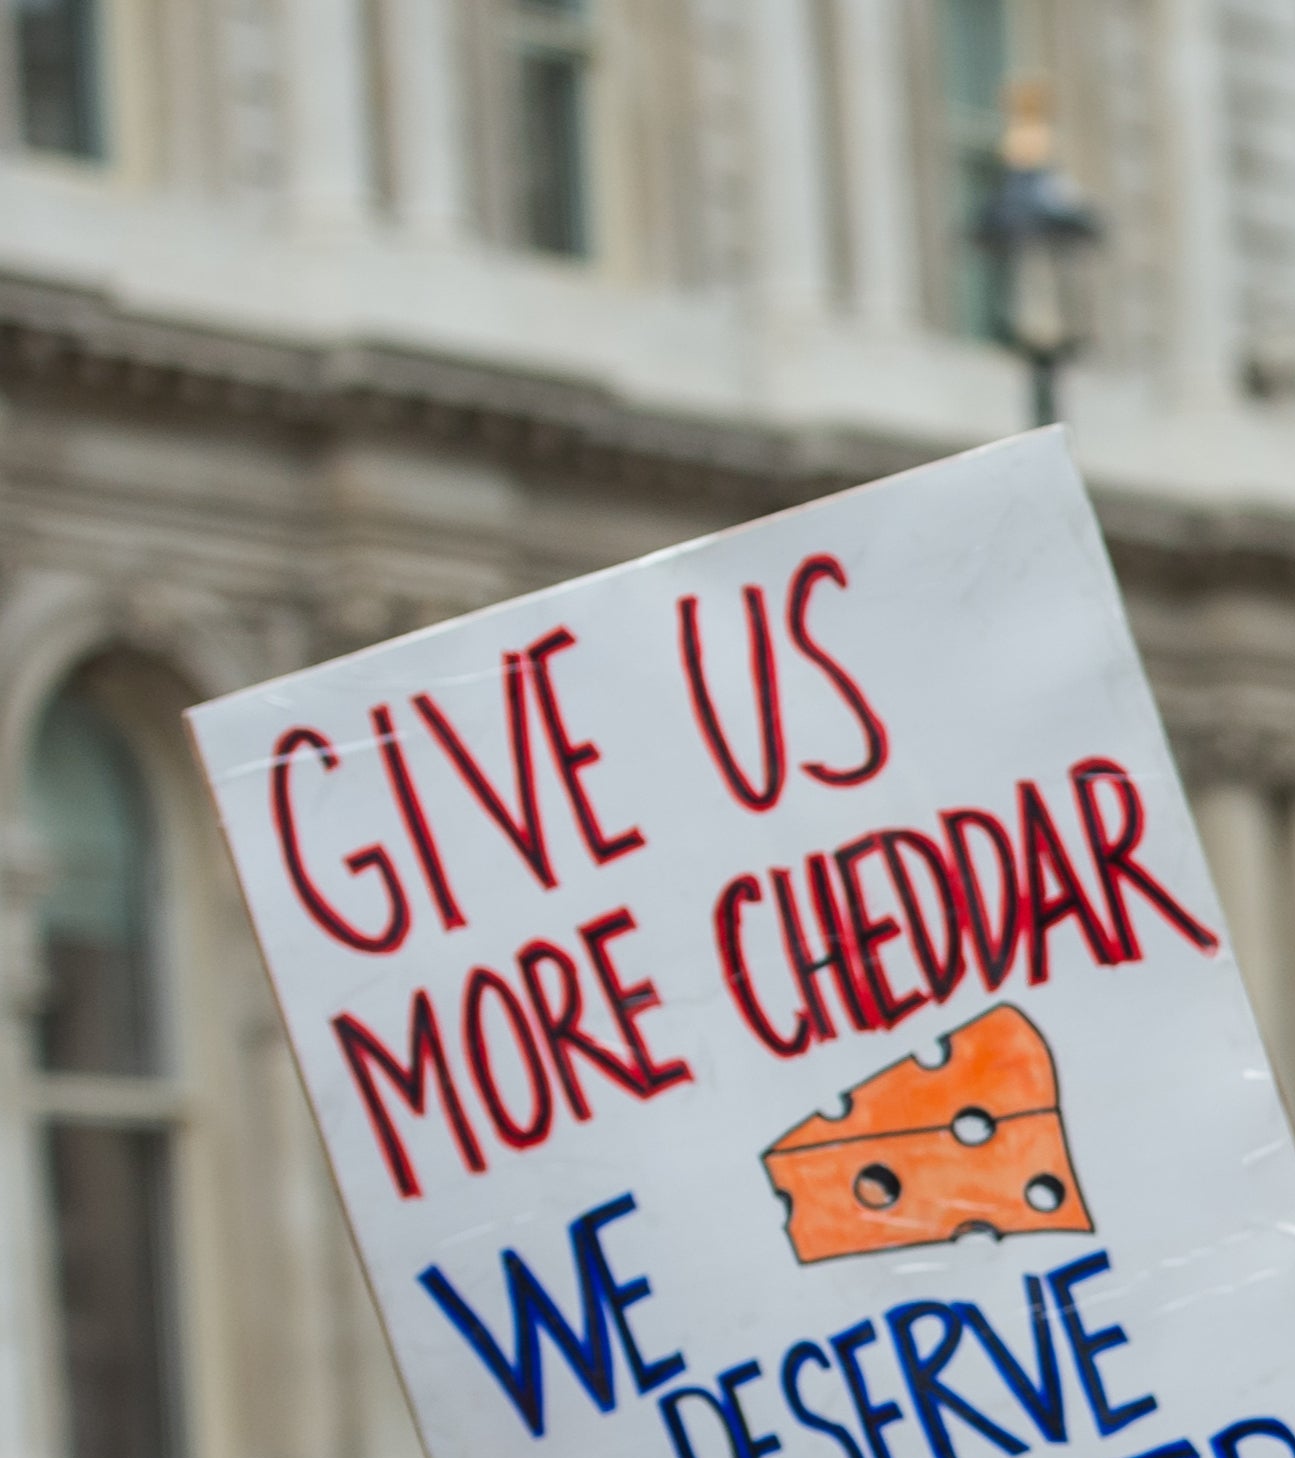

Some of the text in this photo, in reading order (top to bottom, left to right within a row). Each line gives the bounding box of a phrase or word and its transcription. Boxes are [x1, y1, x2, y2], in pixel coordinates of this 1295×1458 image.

[271, 553, 890, 956] GIVE US
[331, 757, 1222, 1198] MORE CHEDDAR
[416, 1193, 685, 1439] WE
